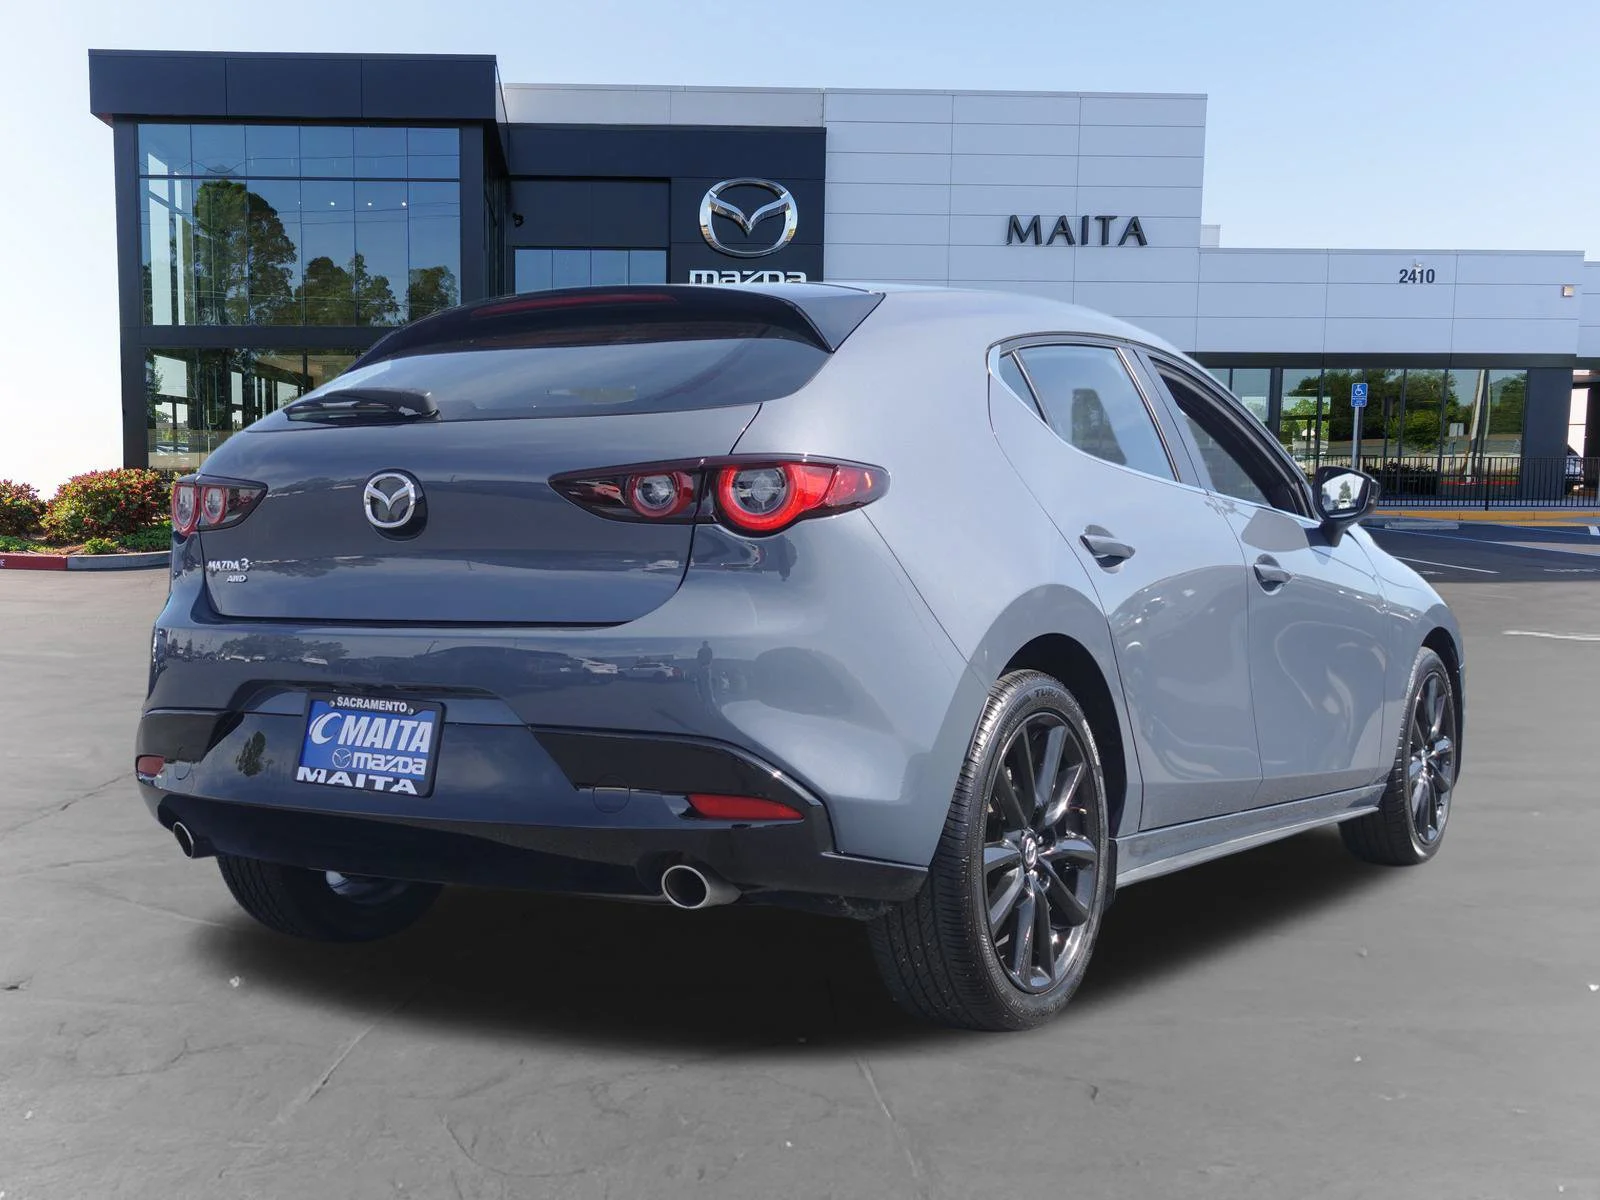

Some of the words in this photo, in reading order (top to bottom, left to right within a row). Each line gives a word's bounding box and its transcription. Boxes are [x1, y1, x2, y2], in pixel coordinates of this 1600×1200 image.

[1006, 214, 1148, 246] MAITA
[1399, 268, 1435, 284] 2410
[336, 696, 408, 713] SACRAMENTO
[296, 766, 418, 795] MAITA
